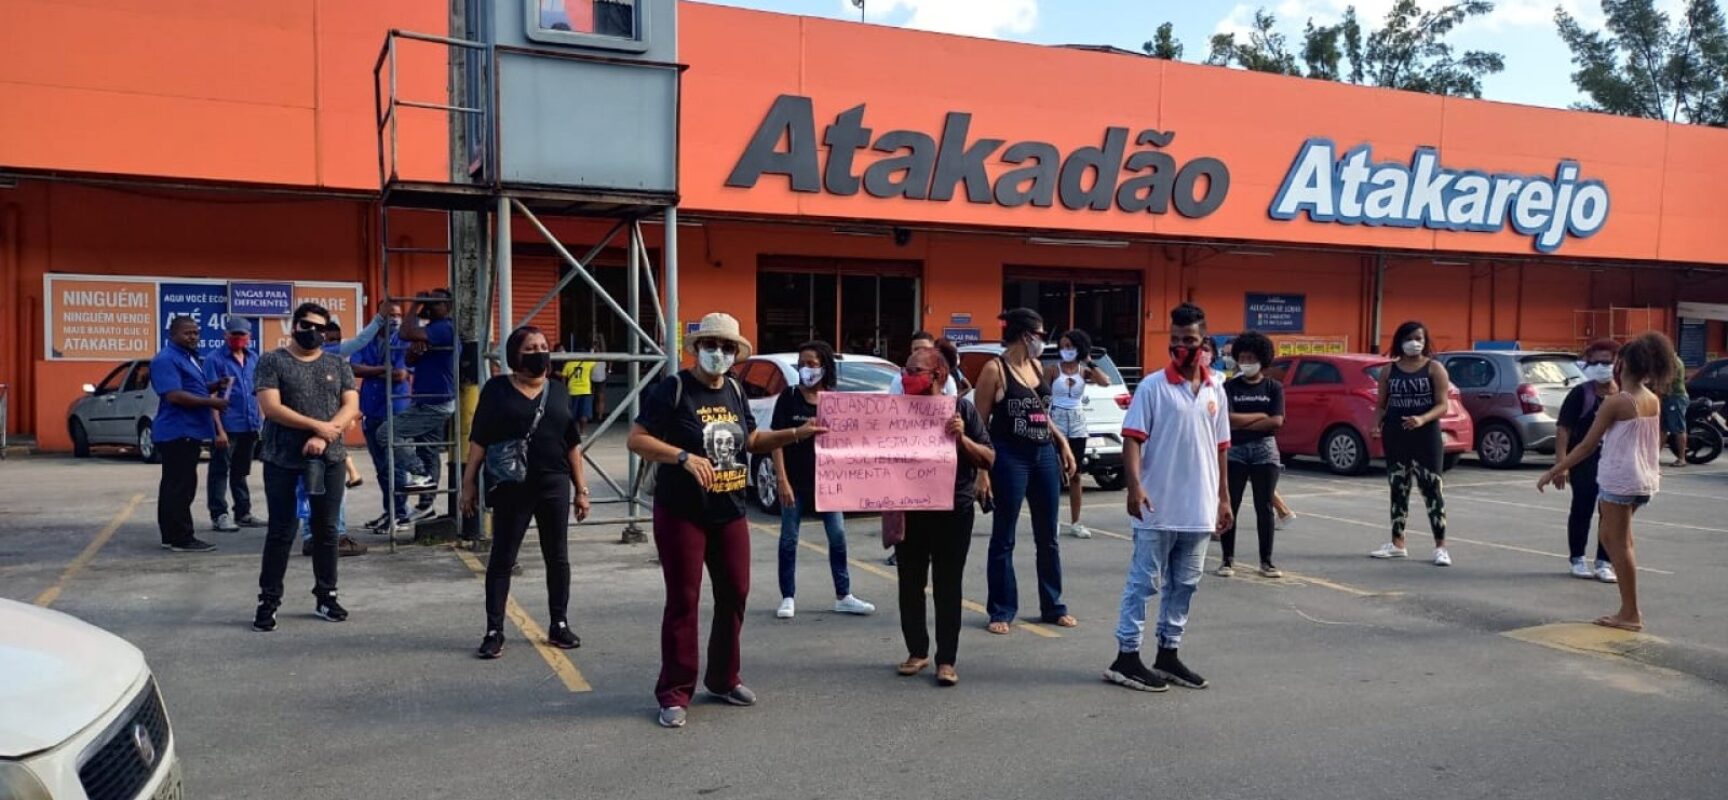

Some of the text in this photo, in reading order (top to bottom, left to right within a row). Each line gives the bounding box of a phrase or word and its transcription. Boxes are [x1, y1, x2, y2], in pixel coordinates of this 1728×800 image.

[723, 94, 1231, 219] Atakadão
[1272, 141, 1609, 249] Atakarejo
[63, 289, 148, 308] NINGUÉM!
[235, 290, 287, 299] VAGAS PARA
[234, 299, 288, 307] DEFICIENTES
[116, 312, 150, 324] VENDE
[63, 338, 148, 351] ATAKAREJO!
[905, 467, 937, 481] COM
[819, 483, 842, 495] ELA
